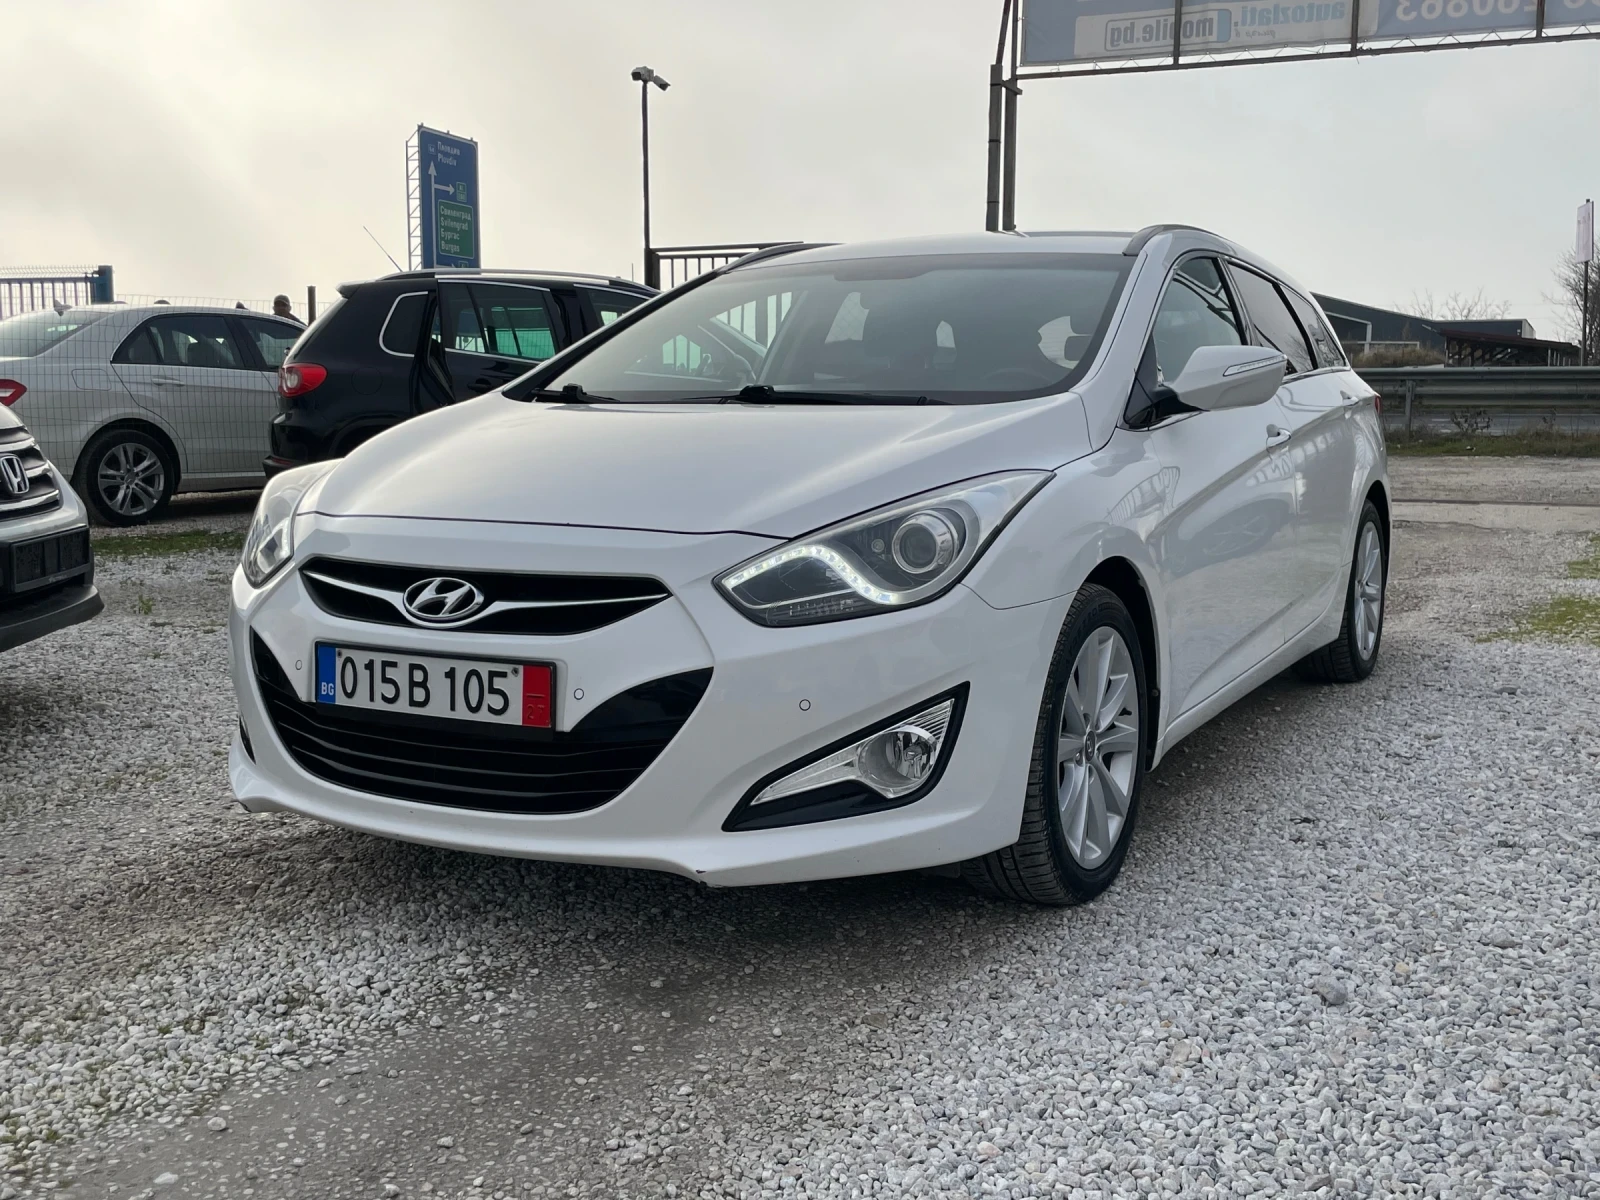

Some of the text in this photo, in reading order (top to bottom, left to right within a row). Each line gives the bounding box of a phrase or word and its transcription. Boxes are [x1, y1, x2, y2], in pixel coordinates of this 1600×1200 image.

[437, 141, 460, 156] Пловдив
[437, 153, 457, 167] Plovdiv
[440, 205, 471, 221] Свиленград
[440, 216, 469, 232] Svilengrad
[440, 228, 460, 241] Бургас
[441, 240, 460, 254] Burgas
[321, 681, 335, 696] BG
